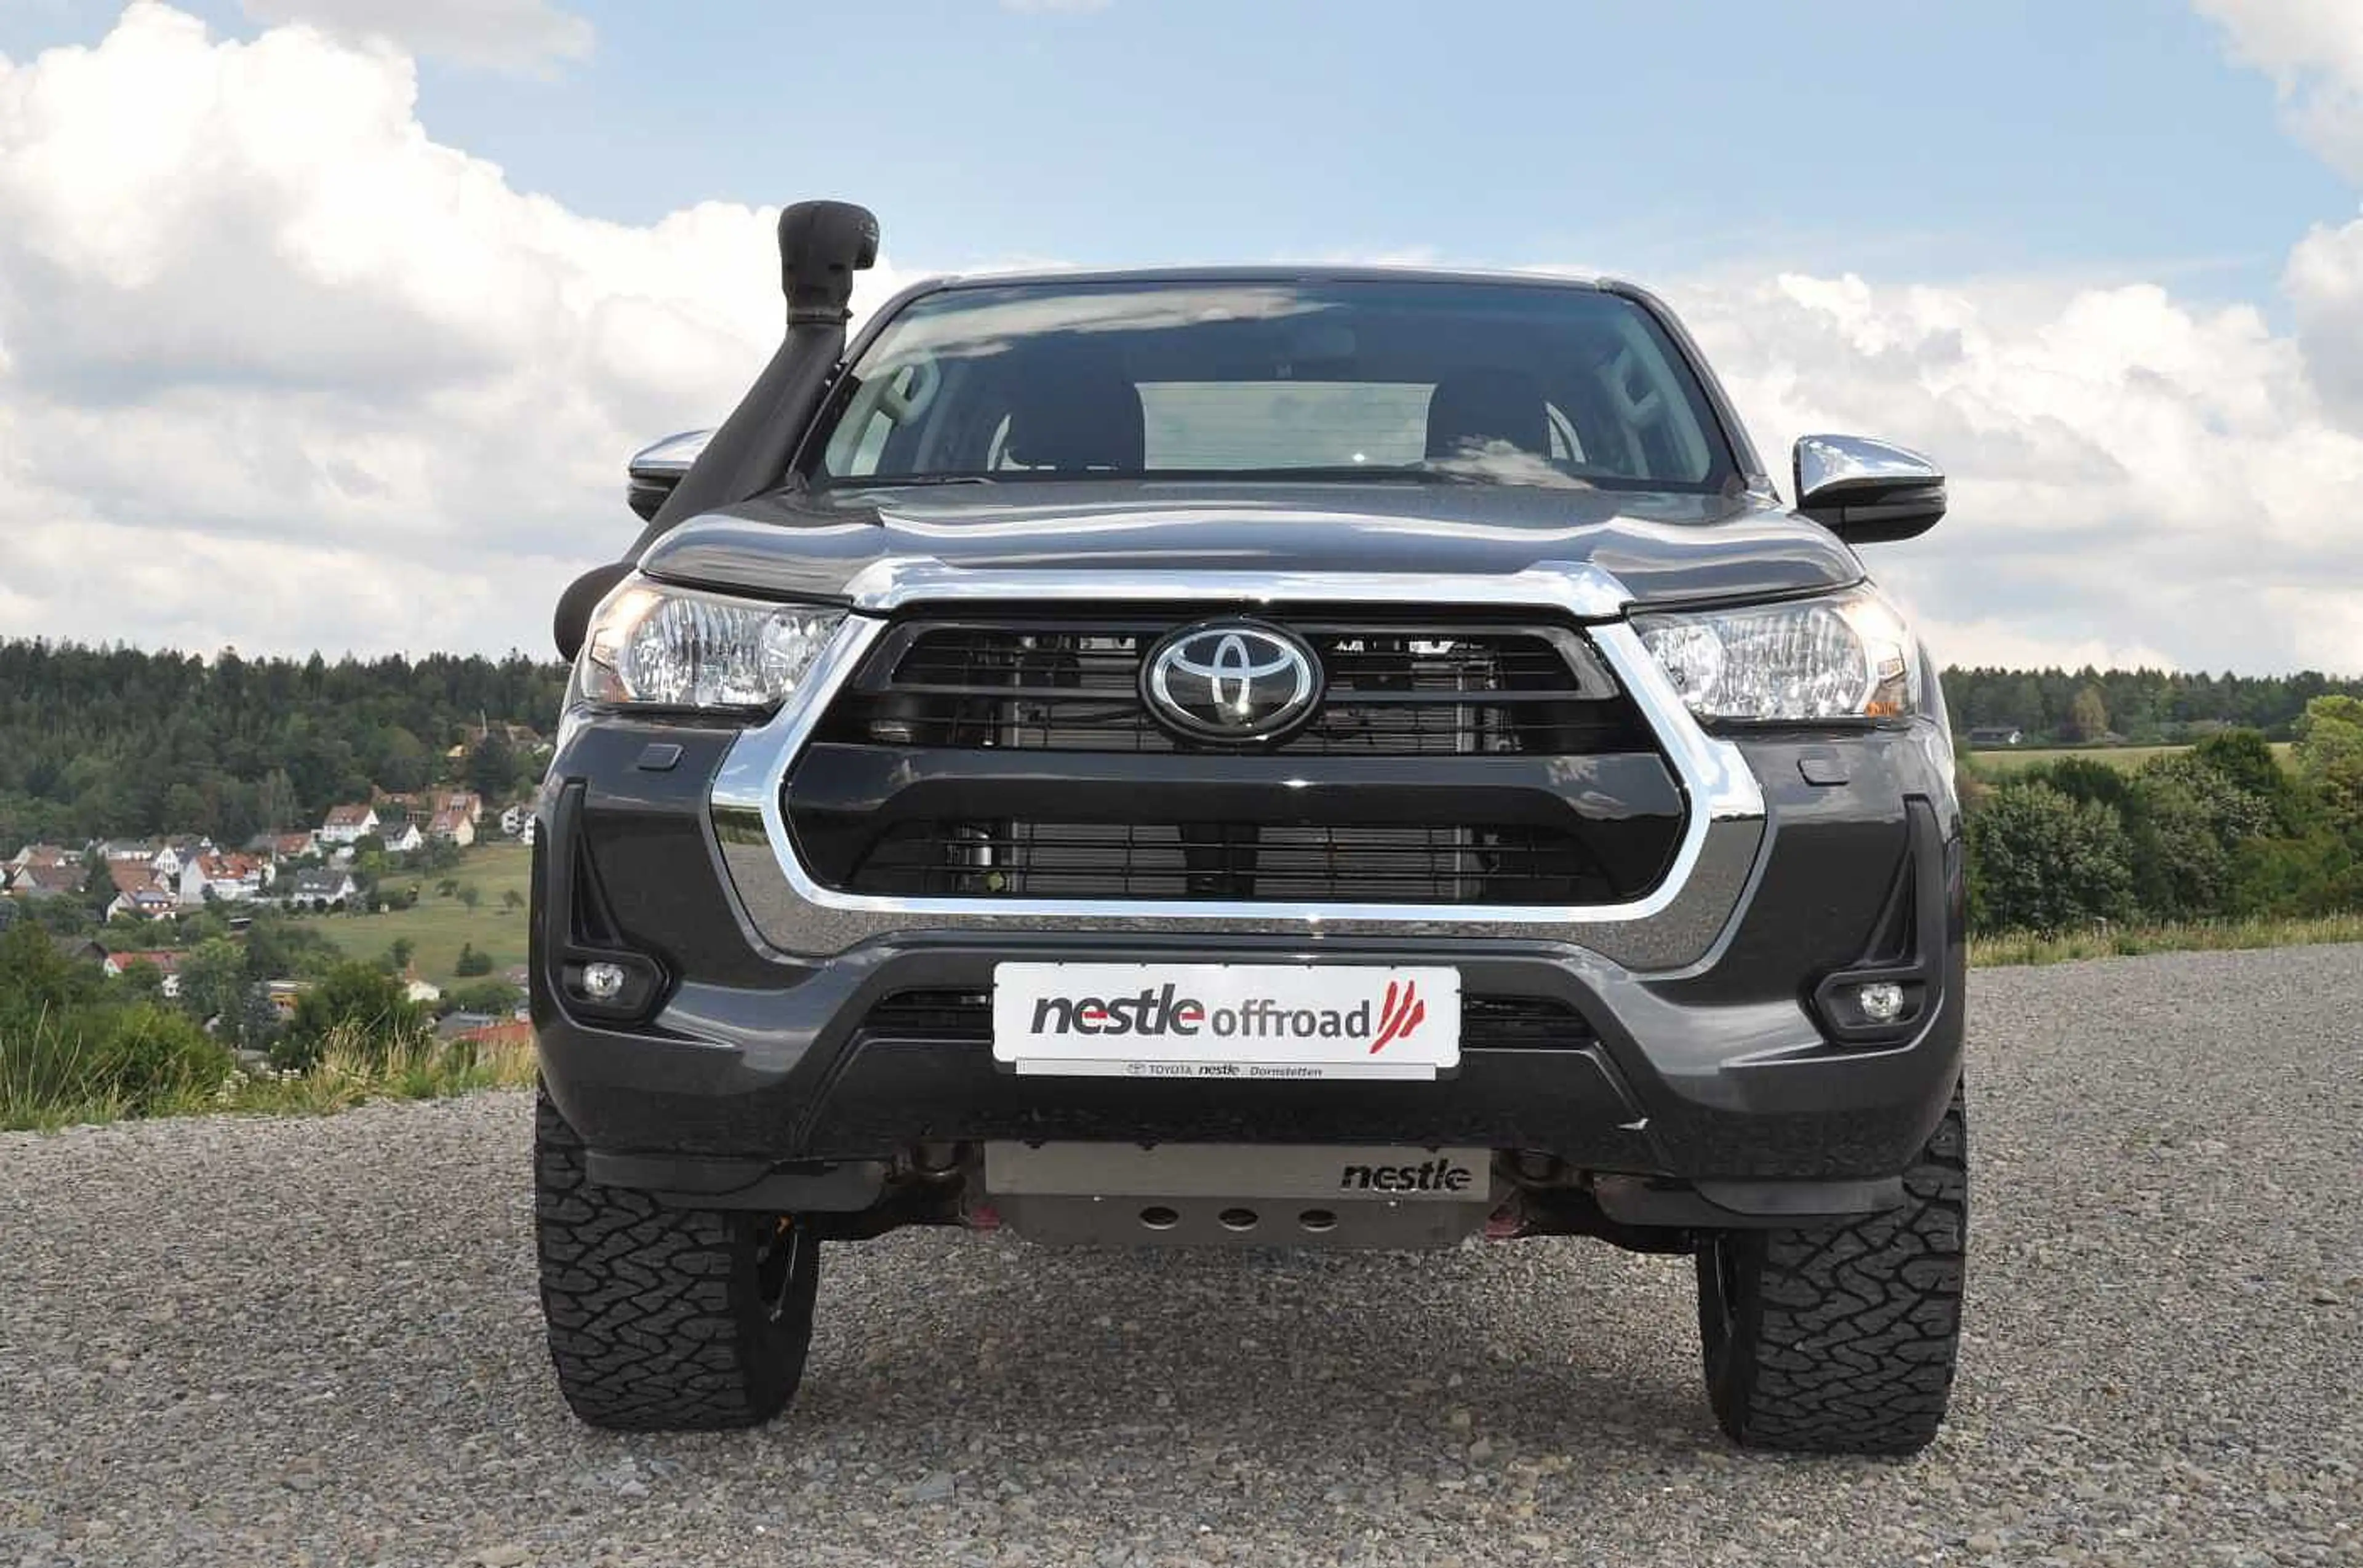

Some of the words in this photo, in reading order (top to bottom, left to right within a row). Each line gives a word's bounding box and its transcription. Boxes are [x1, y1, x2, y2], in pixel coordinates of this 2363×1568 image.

[1031, 983, 1205, 1036] nestle
[1212, 999, 1371, 1039] offroad
[1149, 1065, 1193, 1075] TOYOTA
[1340, 1158, 1472, 1191] nestle
